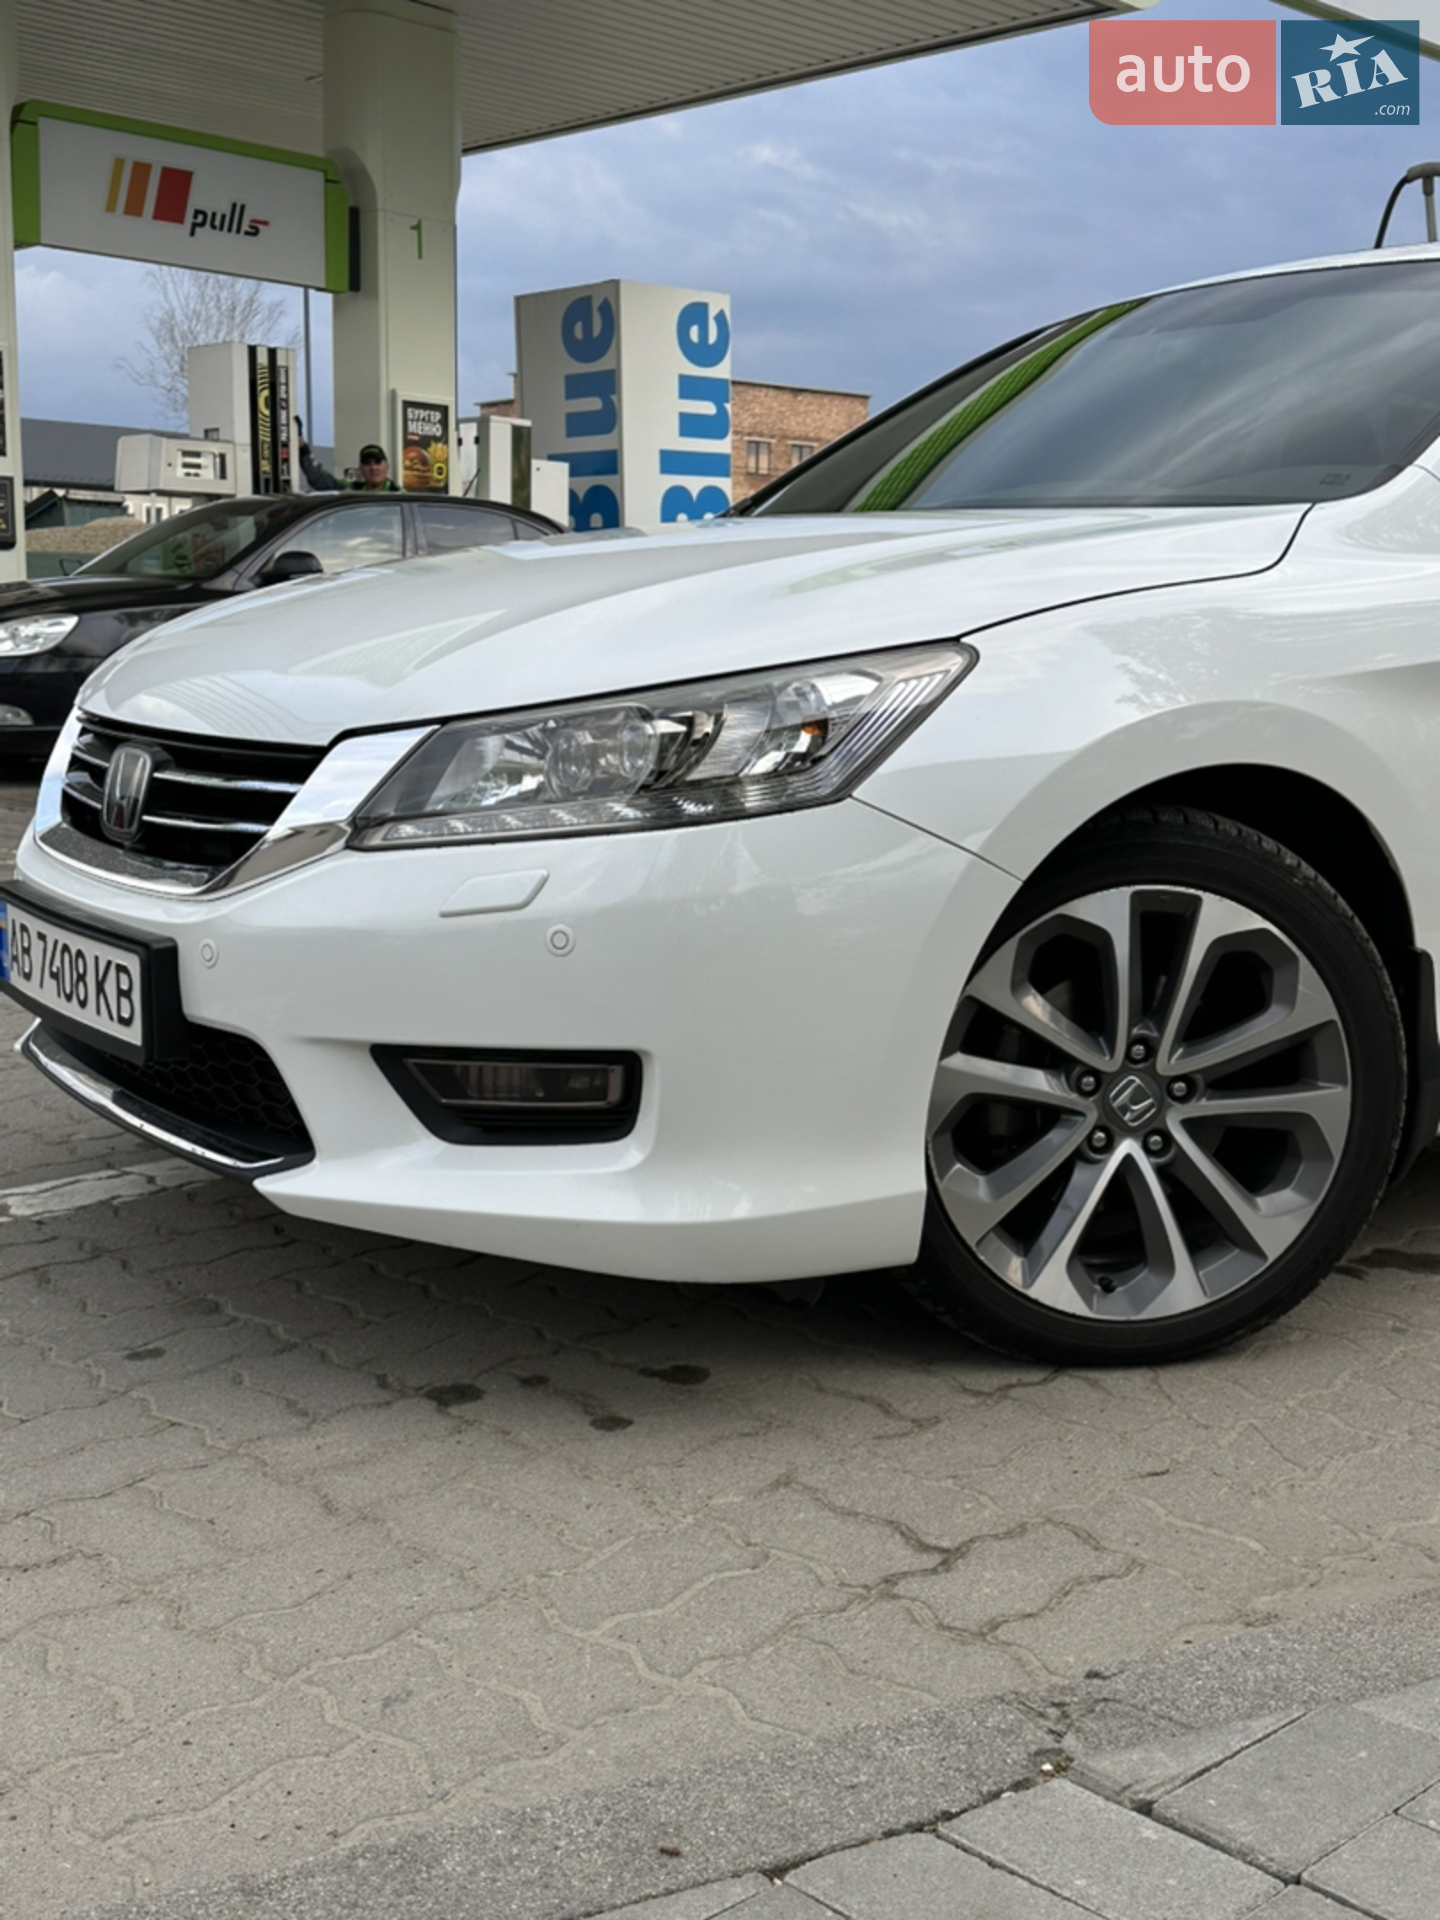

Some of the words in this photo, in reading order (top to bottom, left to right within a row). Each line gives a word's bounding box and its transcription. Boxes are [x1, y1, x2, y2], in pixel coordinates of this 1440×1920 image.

[189, 202, 269, 238] pulls
[410, 218, 423, 260] 1
[406, 407, 442, 423] БУРГЕР
[406, 420, 443, 437] МЕНЮ
[659, 300, 731, 524] Blue
[10, 918, 33, 982] AB
[37, 931, 88, 1010] 7408
[94, 954, 135, 1028] KB
